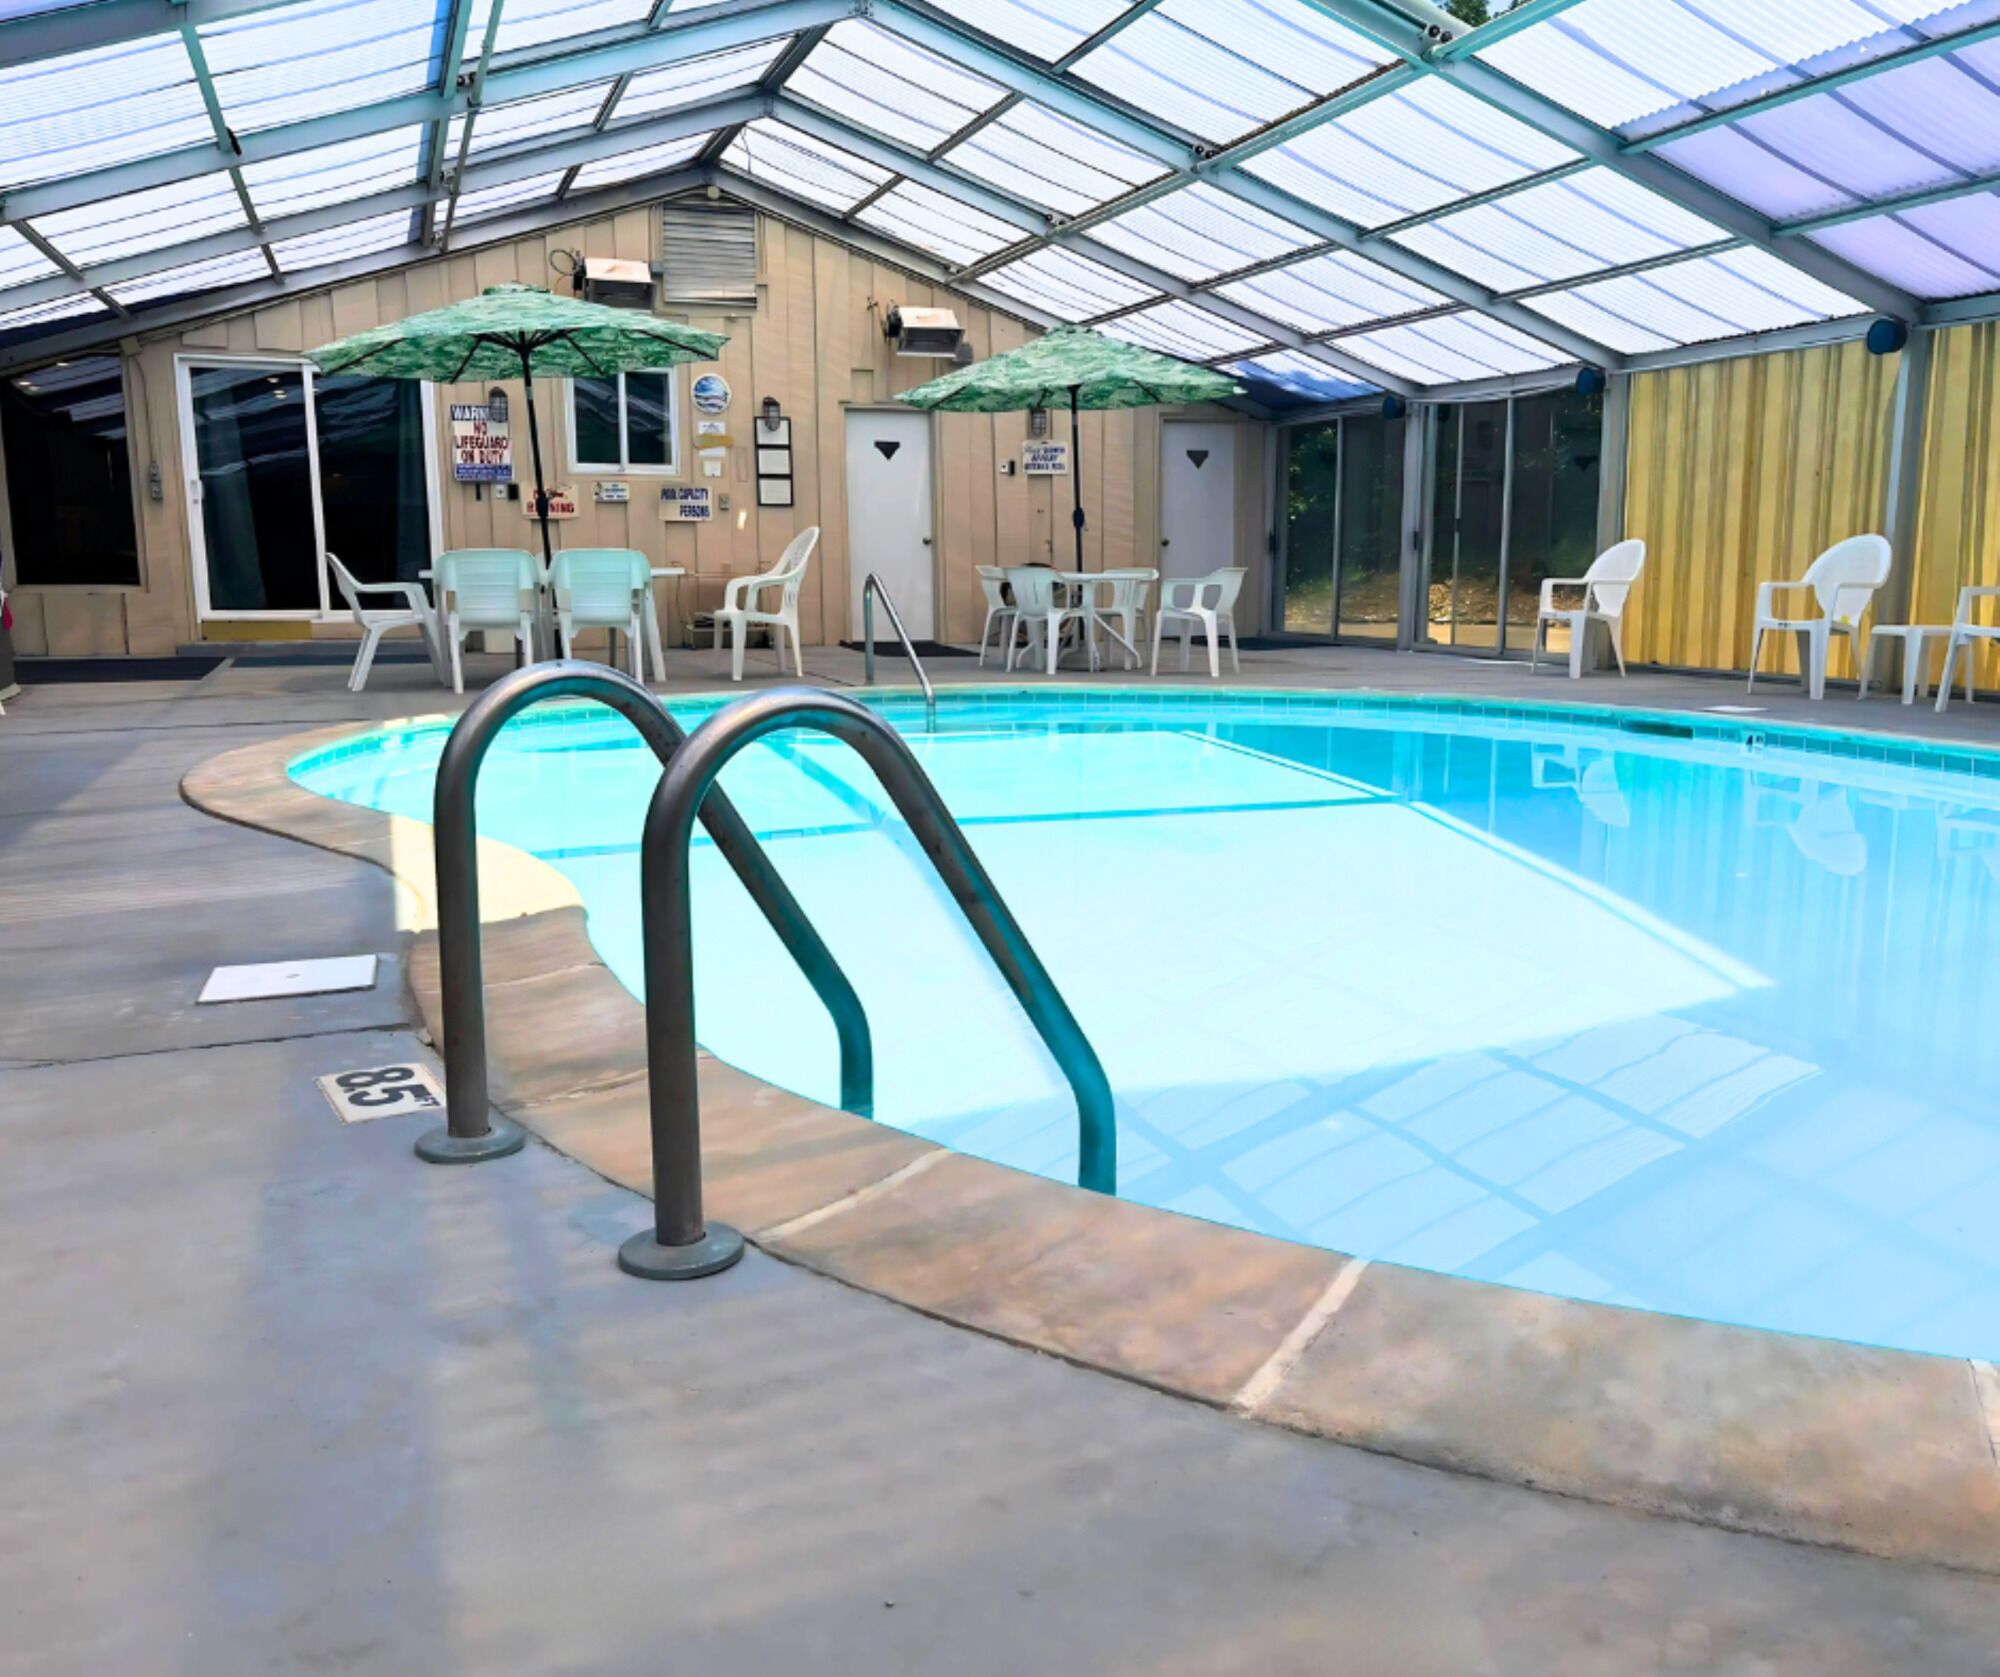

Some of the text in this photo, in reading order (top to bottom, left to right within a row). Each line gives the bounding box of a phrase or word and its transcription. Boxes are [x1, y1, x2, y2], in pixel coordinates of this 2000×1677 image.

[473, 421, 488, 435] NO
[455, 435, 509, 449] LIFEGUARD
[461, 450, 504, 464] ON DUTY
